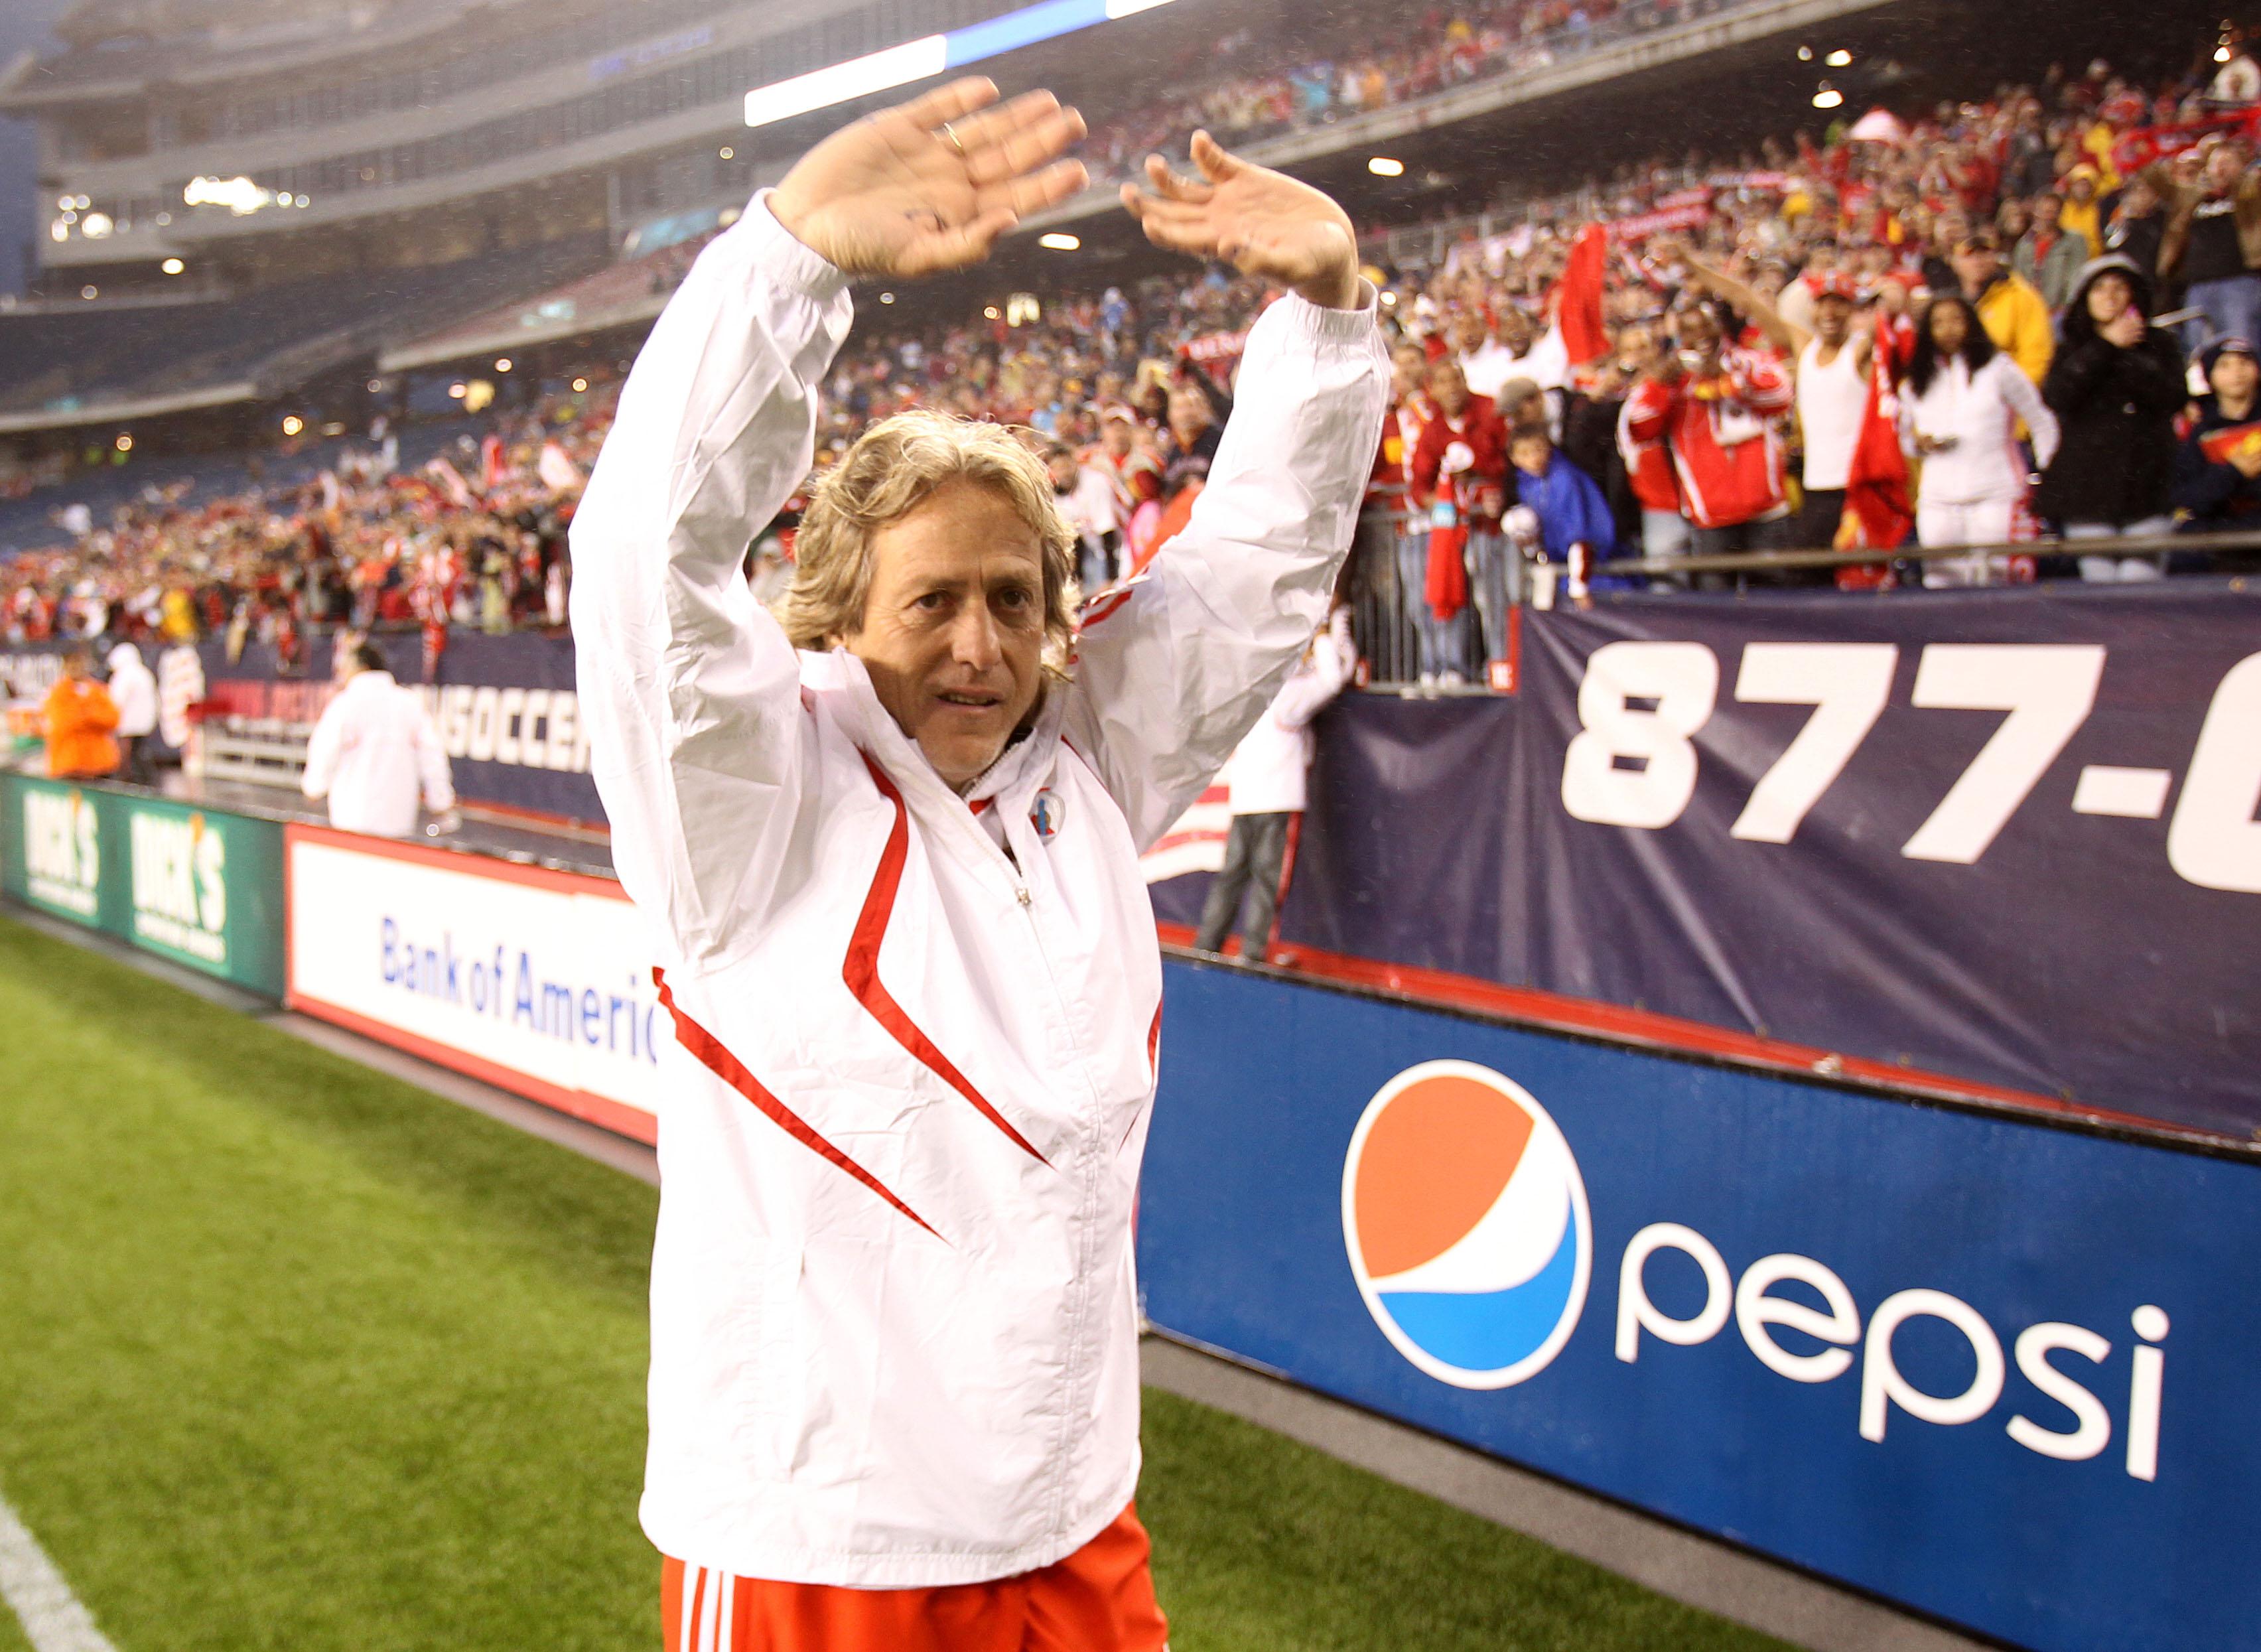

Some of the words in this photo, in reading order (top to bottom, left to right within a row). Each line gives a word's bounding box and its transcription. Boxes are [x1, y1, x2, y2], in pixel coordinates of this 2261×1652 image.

[413, 683, 590, 774] SOCCE
[381, 914, 463, 1007] Bank
[470, 945, 504, 1016] of
[1615, 1222, 2169, 1482] pepsi
